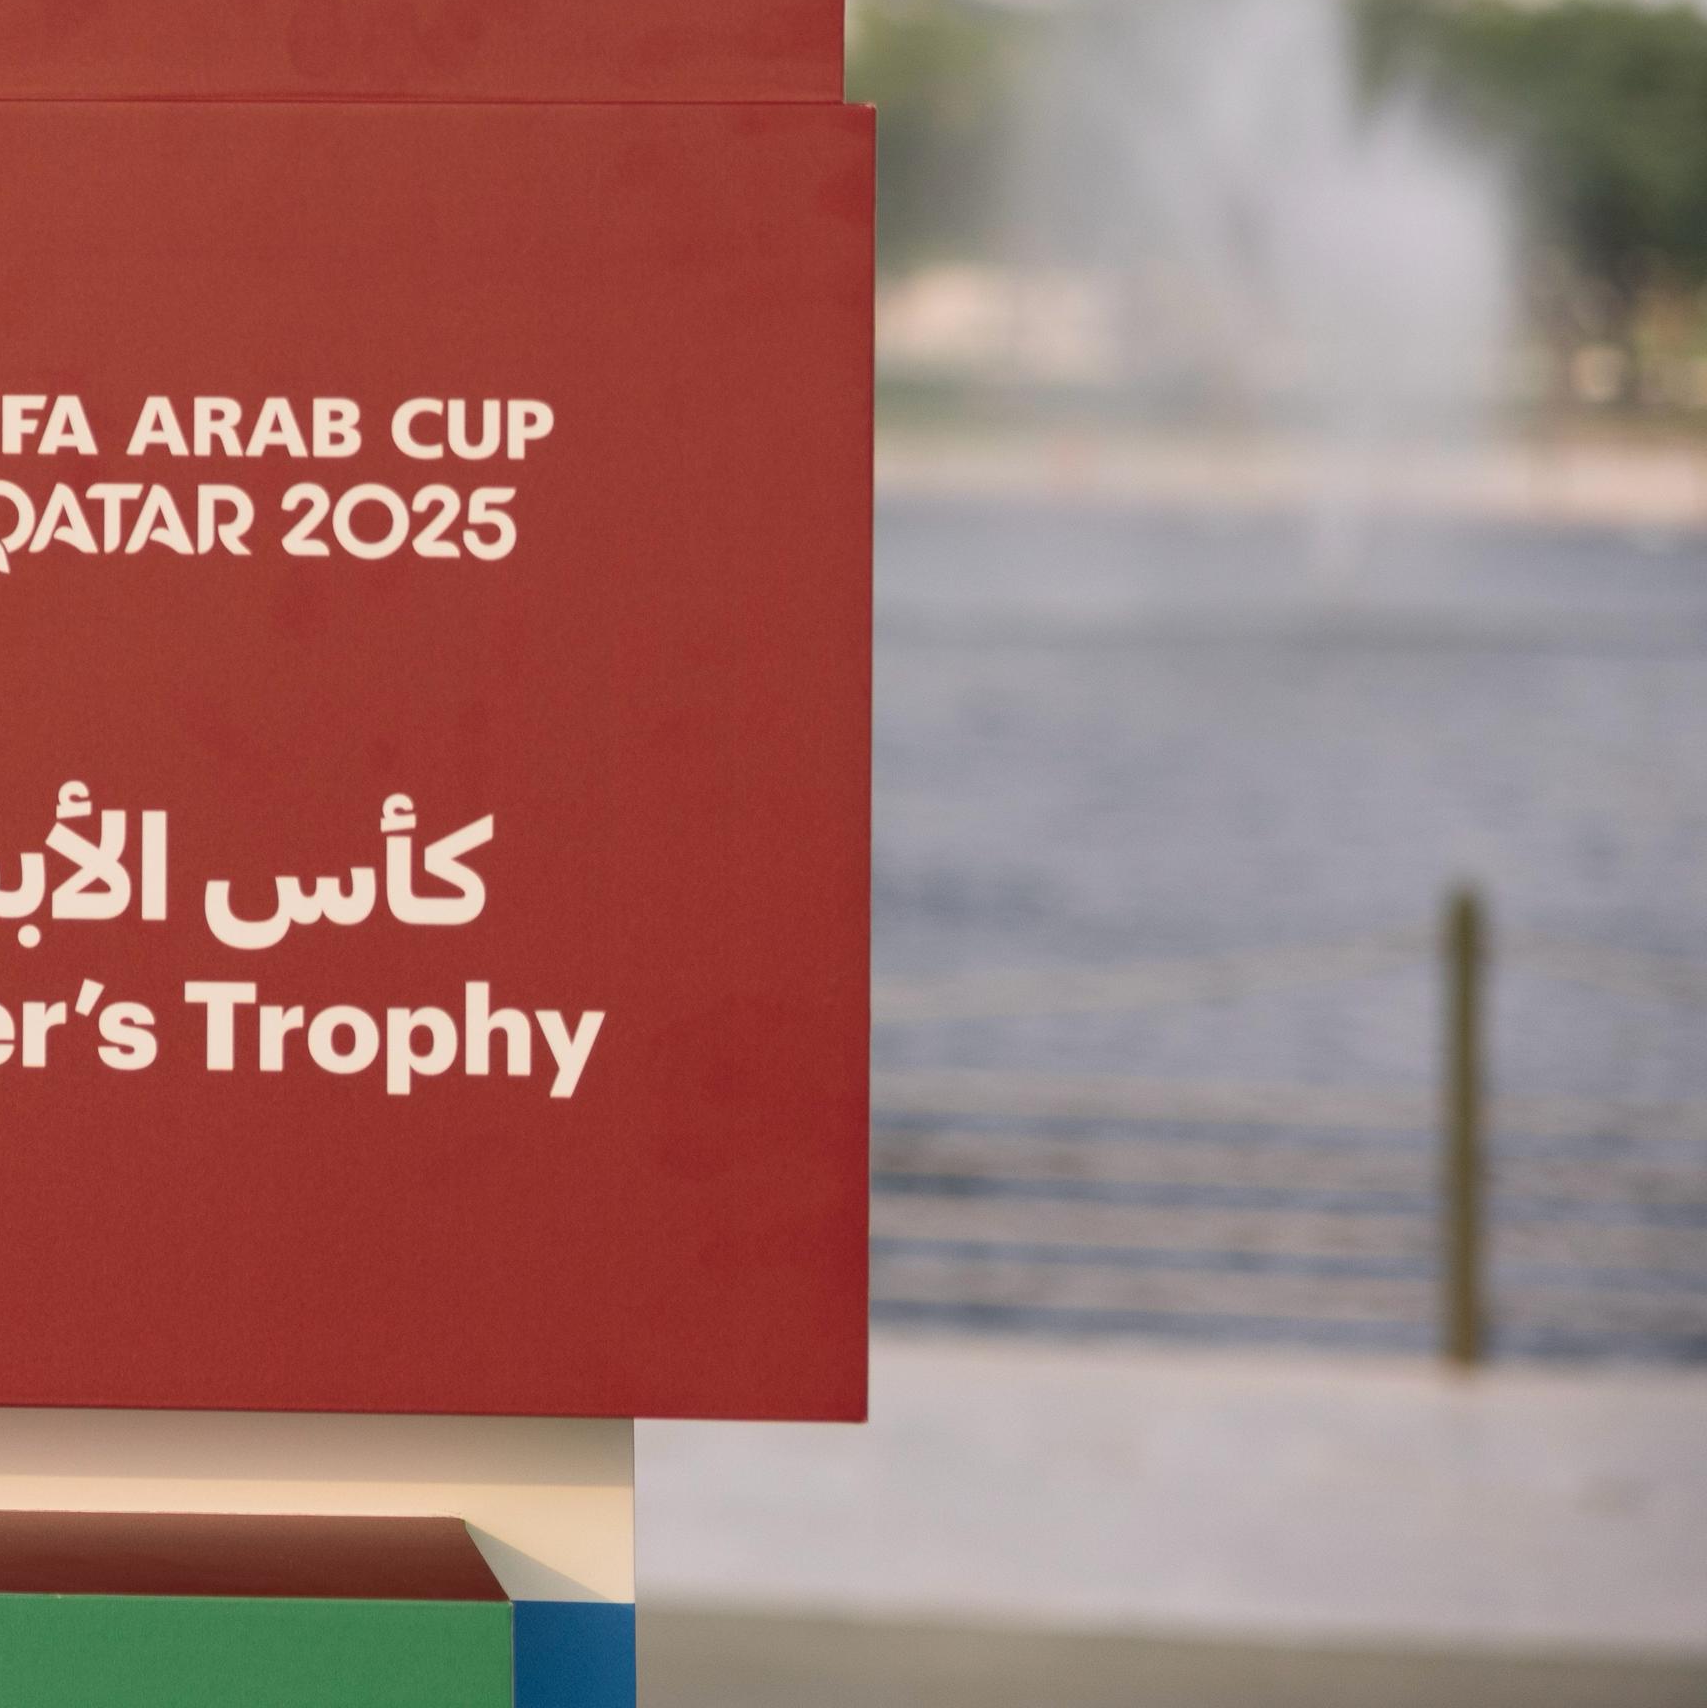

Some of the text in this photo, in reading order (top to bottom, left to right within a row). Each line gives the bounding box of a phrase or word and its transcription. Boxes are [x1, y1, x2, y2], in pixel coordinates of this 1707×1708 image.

[125, 395, 362, 458] ARAB
[390, 397, 555, 461] CUP
[280, 482, 517, 561] 2025
[204, 792, 494, 950] كأس
[184, 980, 606, 1099] Trophy
